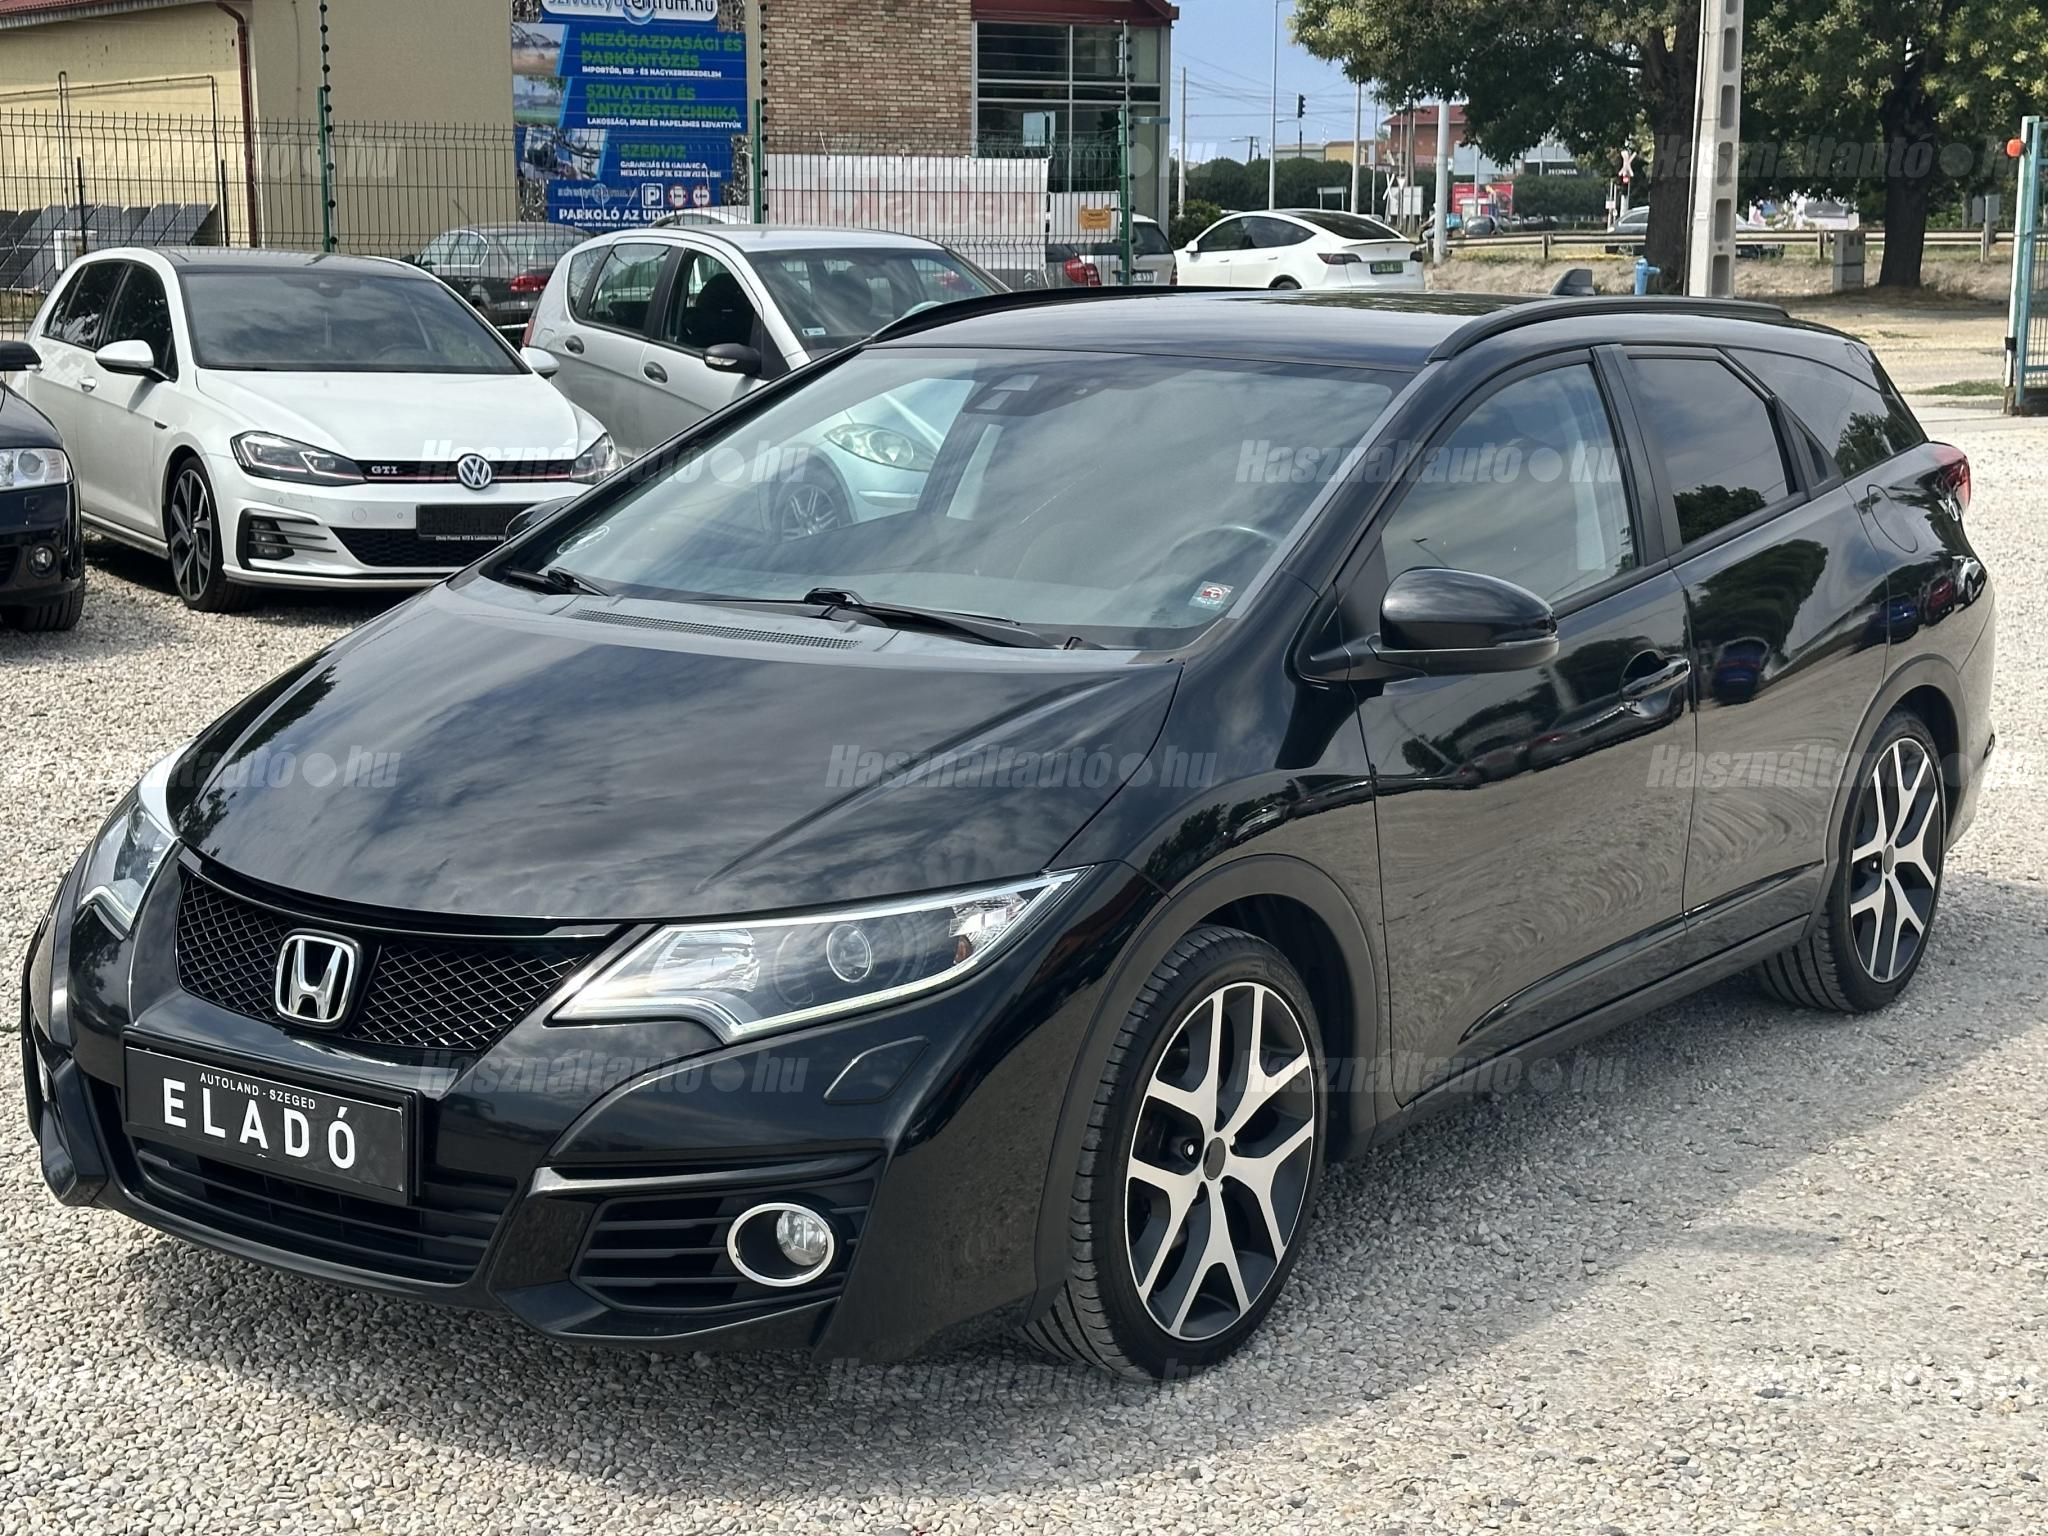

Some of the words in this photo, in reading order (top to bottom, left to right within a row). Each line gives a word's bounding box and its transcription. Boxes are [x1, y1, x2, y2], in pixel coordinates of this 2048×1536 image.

[581, 31, 719, 50] MEZŐGAZDASÁGI
[724, 34, 742, 51] ÉS
[586, 83, 673, 99] SZIVATTYÚ
[677, 84, 696, 100] ÉS
[620, 144, 686, 158] SZERVIZ
[1548, 168, 1577, 176] HONDA
[559, 206, 620, 220] PARKOLÓ
[622, 209, 640, 220] AZ
[371, 465, 398, 474] GTI
[200, 1071, 260, 1097] AUTOLAND
[269, 1089, 316, 1111] SZEGED
[163, 1077, 356, 1170] ELADÓ
